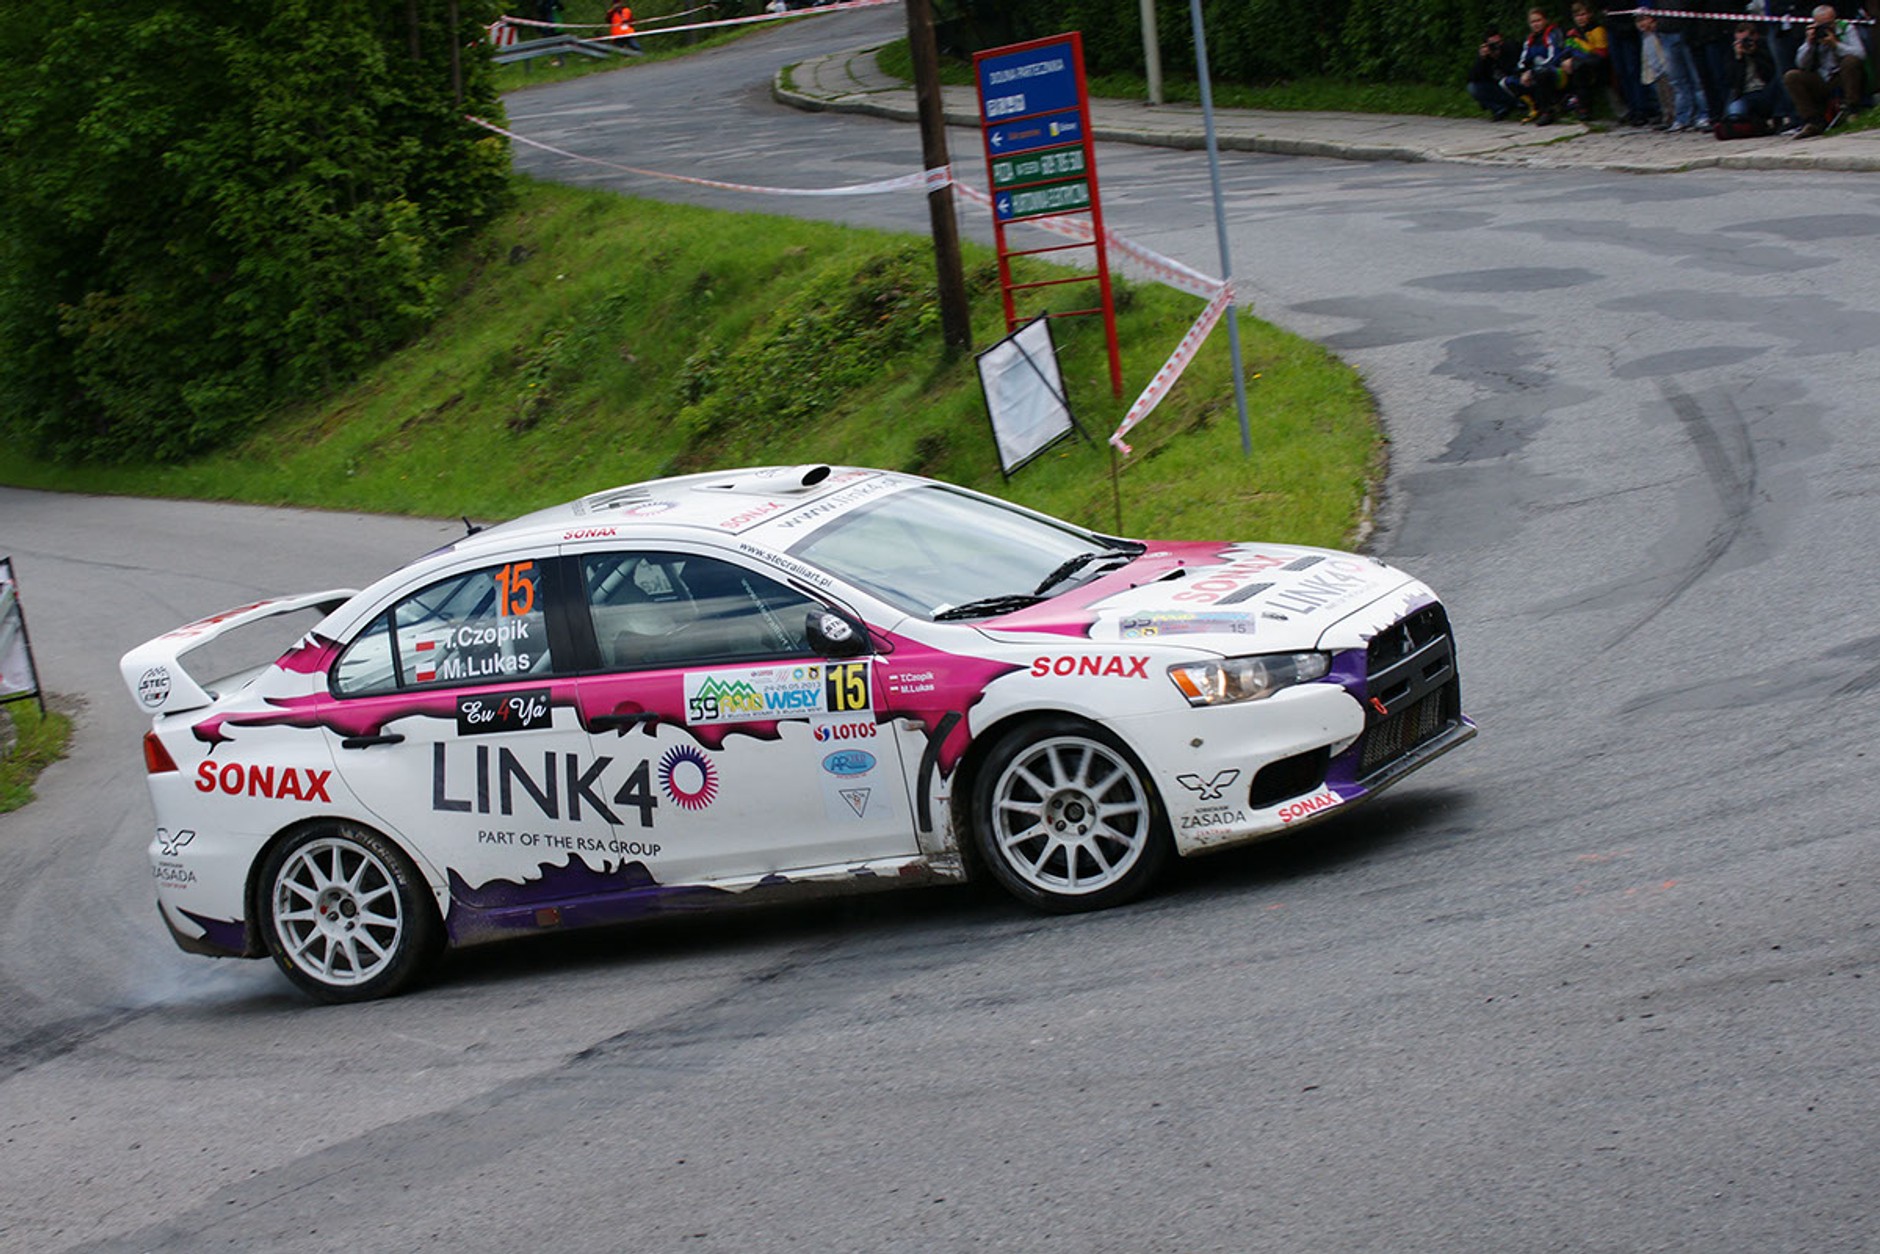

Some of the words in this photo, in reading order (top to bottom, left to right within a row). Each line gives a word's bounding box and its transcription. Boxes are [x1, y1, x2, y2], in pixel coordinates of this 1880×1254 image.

[719, 501, 785, 531] SONAX
[563, 527, 618, 540] SONAX
[494, 561, 534, 617] 15
[1171, 553, 1297, 604] SONAX
[445, 620, 529, 649] T.Czopik
[1230, 623, 1247, 634] 15
[443, 652, 531, 680] M.Lukas
[1030, 655, 1151, 680] SONAX
[828, 663, 867, 711] 15
[690, 697, 719, 720] 59
[832, 722, 877, 740] LOTOS
[194, 760, 332, 803] SONAX
[1181, 810, 1247, 829] ZASADA
[1278, 793, 1337, 823] SONAX
[478, 830, 516, 845] PART
[520, 832, 541, 847] OF
[544, 834, 573, 850] THE
[577, 838, 606, 852] RSA
[608, 840, 661, 857] GROUP
